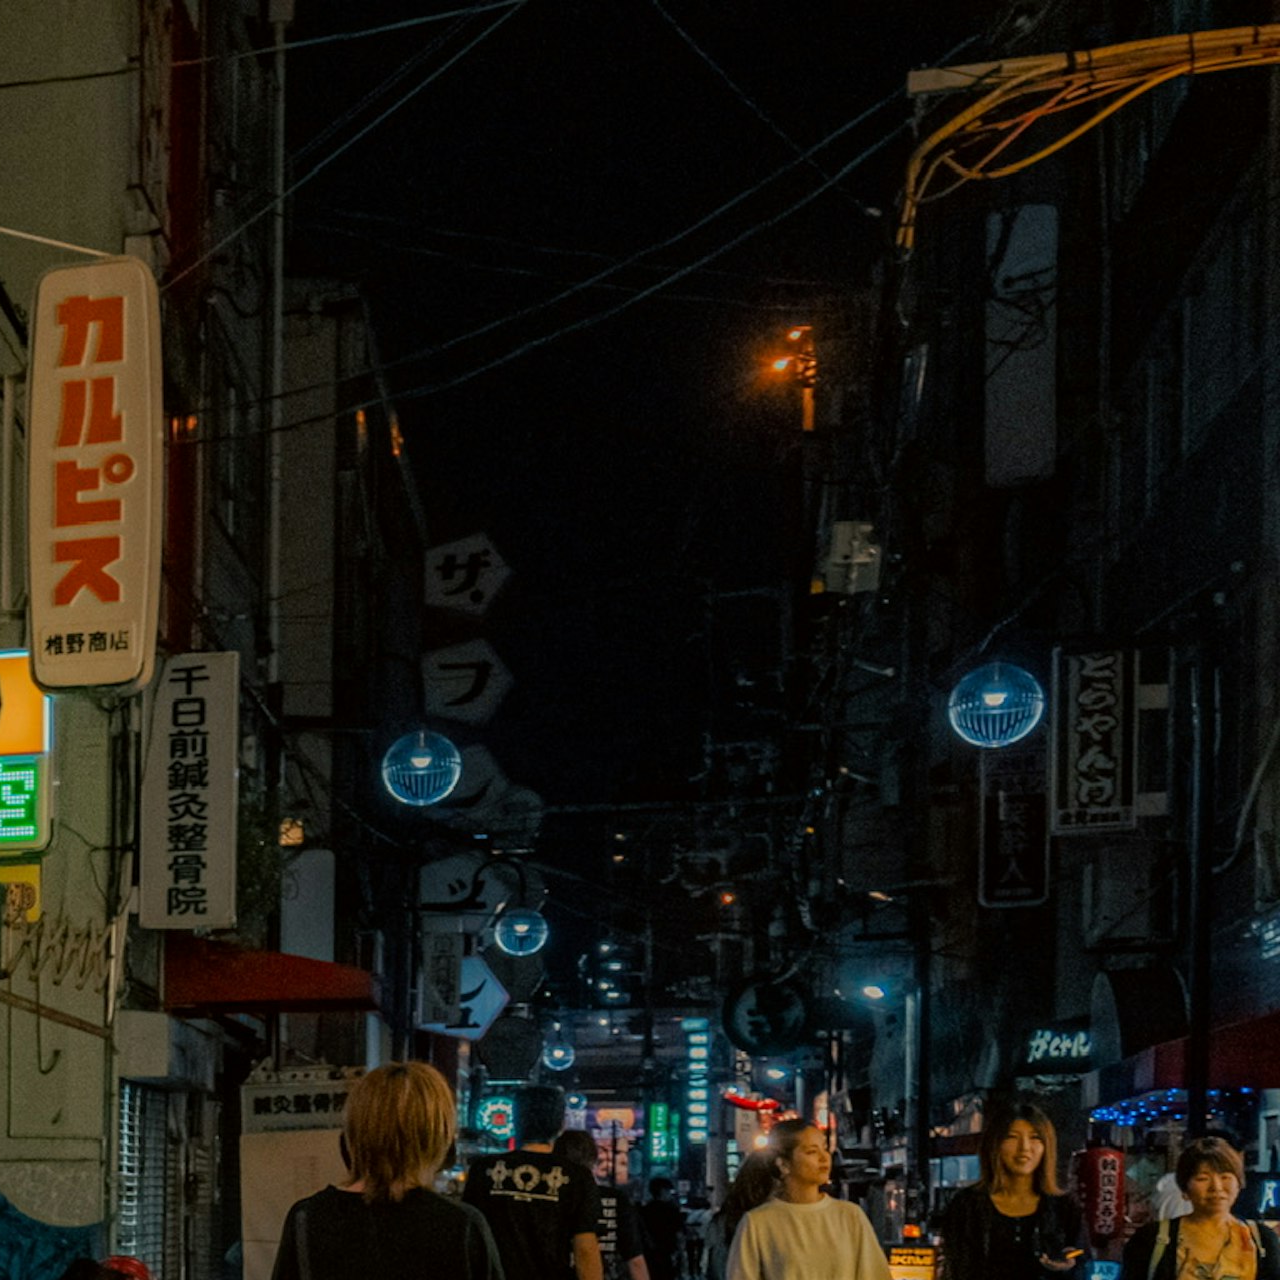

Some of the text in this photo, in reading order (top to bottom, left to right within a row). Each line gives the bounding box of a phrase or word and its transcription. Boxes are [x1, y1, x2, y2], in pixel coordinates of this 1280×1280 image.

[52, 294, 136, 607] カルピス
[167, 664, 211, 917] 千日前鍼灸整骨院
